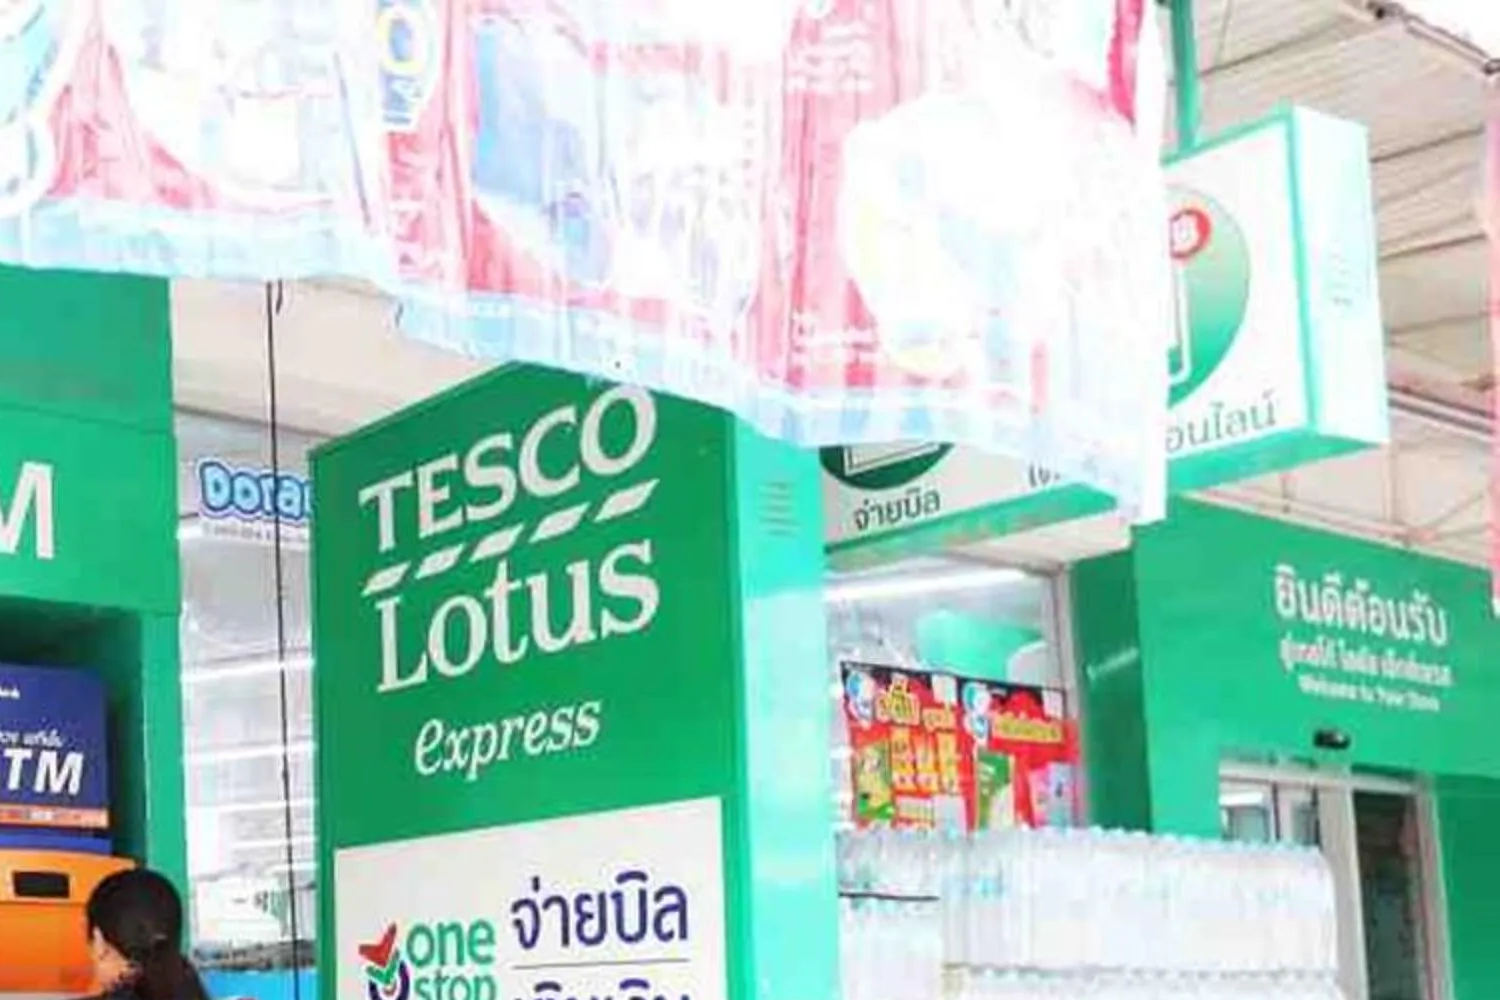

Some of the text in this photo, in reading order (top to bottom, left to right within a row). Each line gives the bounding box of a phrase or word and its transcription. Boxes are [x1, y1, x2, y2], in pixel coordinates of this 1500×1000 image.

[358, 384, 658, 553] TESCO
[853, 486, 941, 531] จ่ายบิล
[374, 538, 660, 693] Lotus
[1273, 563, 1449, 648] ยินดีต้อนรับ
[413, 699, 602, 781] express
[405, 918, 496, 968] one
[510, 869, 690, 951] จ่ายบิล
